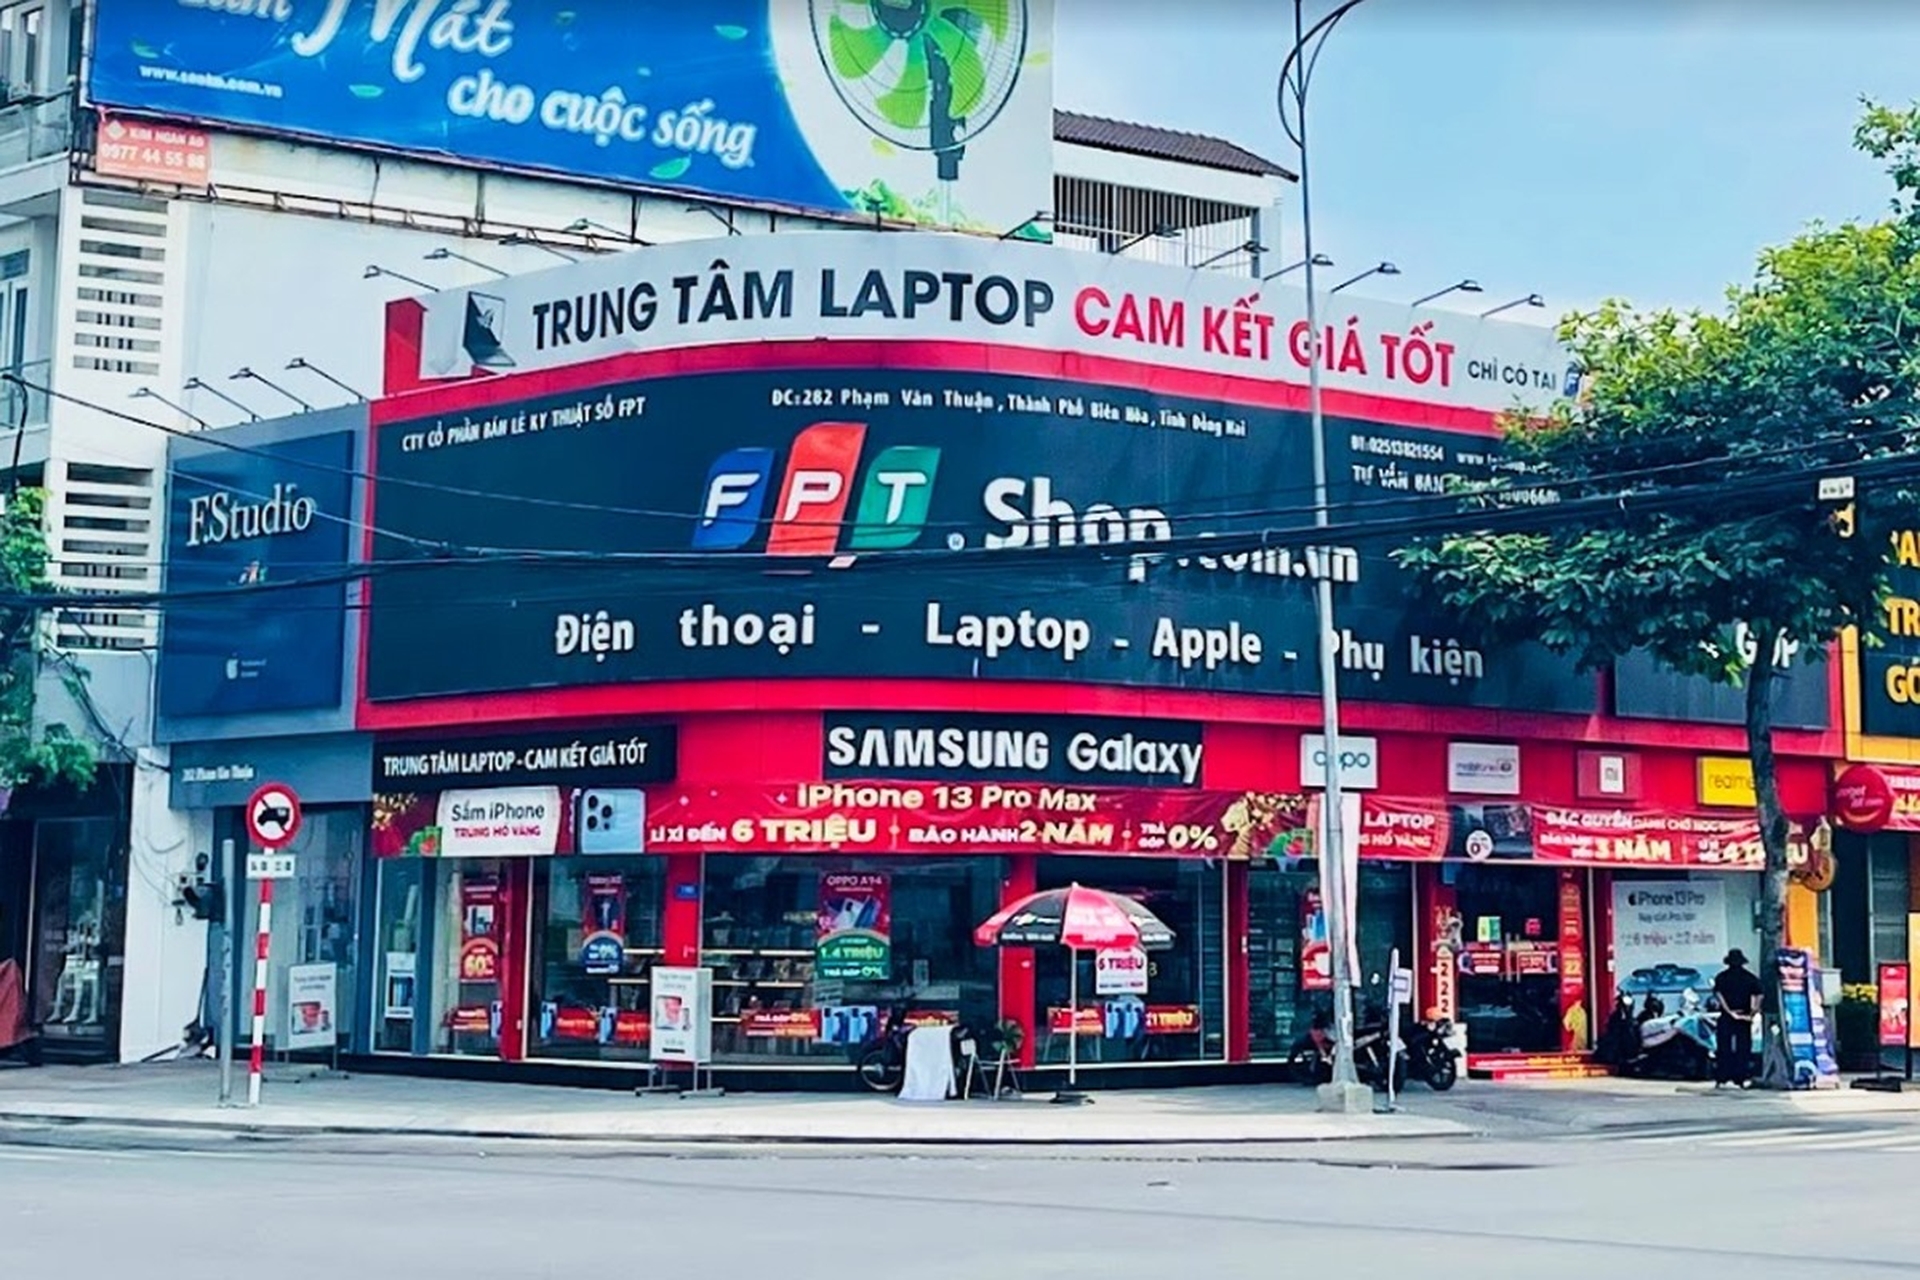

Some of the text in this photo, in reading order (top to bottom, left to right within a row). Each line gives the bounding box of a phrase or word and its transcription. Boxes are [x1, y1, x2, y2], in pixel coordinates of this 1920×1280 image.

[448, 69, 757, 168] cho cuộc sống
[533, 281, 658, 350] TRUNG
[672, 258, 794, 325] TÂM
[819, 268, 1053, 328] LAPTOP
[1074, 286, 1185, 348] CAM
[1203, 293, 1275, 361] KẾT
[1288, 315, 1368, 376] GIÁ
[1380, 321, 1456, 388] TỐT
[402, 432, 425, 451] CTY
[618, 396, 647, 418] FPT
[186, 483, 315, 547] F.Studio
[701, 469, 928, 527] FPT
[555, 610, 634, 661] Điện
[679, 604, 814, 655] thoại
[926, 602, 1091, 661] Laptop
[1151, 617, 1262, 669] Apple
[1410, 634, 1483, 685] kiện
[383, 755, 429, 776] TRUNG
[431, 750, 459, 774] TÂM
[461, 750, 515, 773] LAPTOP
[524, 749, 558, 770] CAM
[559, 740, 588, 768] KẾT
[589, 740, 617, 767] GIÁ
[618, 737, 648, 765] TỐT
[828, 727, 1203, 785] SAMSUNG Galaxy
[1313, 750, 1370, 771] opo
[488, 801, 545, 820] iPhone
[798, 783, 1097, 812] iPhone 13 Pro Max
[731, 819, 755, 843] 6
[760, 812, 877, 850] TRIỆU
[1020, 821, 1036, 843] 2
[1042, 817, 1114, 846] NĂM
[1168, 824, 1219, 850] 0%
[1364, 811, 1434, 830] LAPTOP
[1595, 838, 1611, 860] 3
[1615, 833, 1672, 861] NĂM
